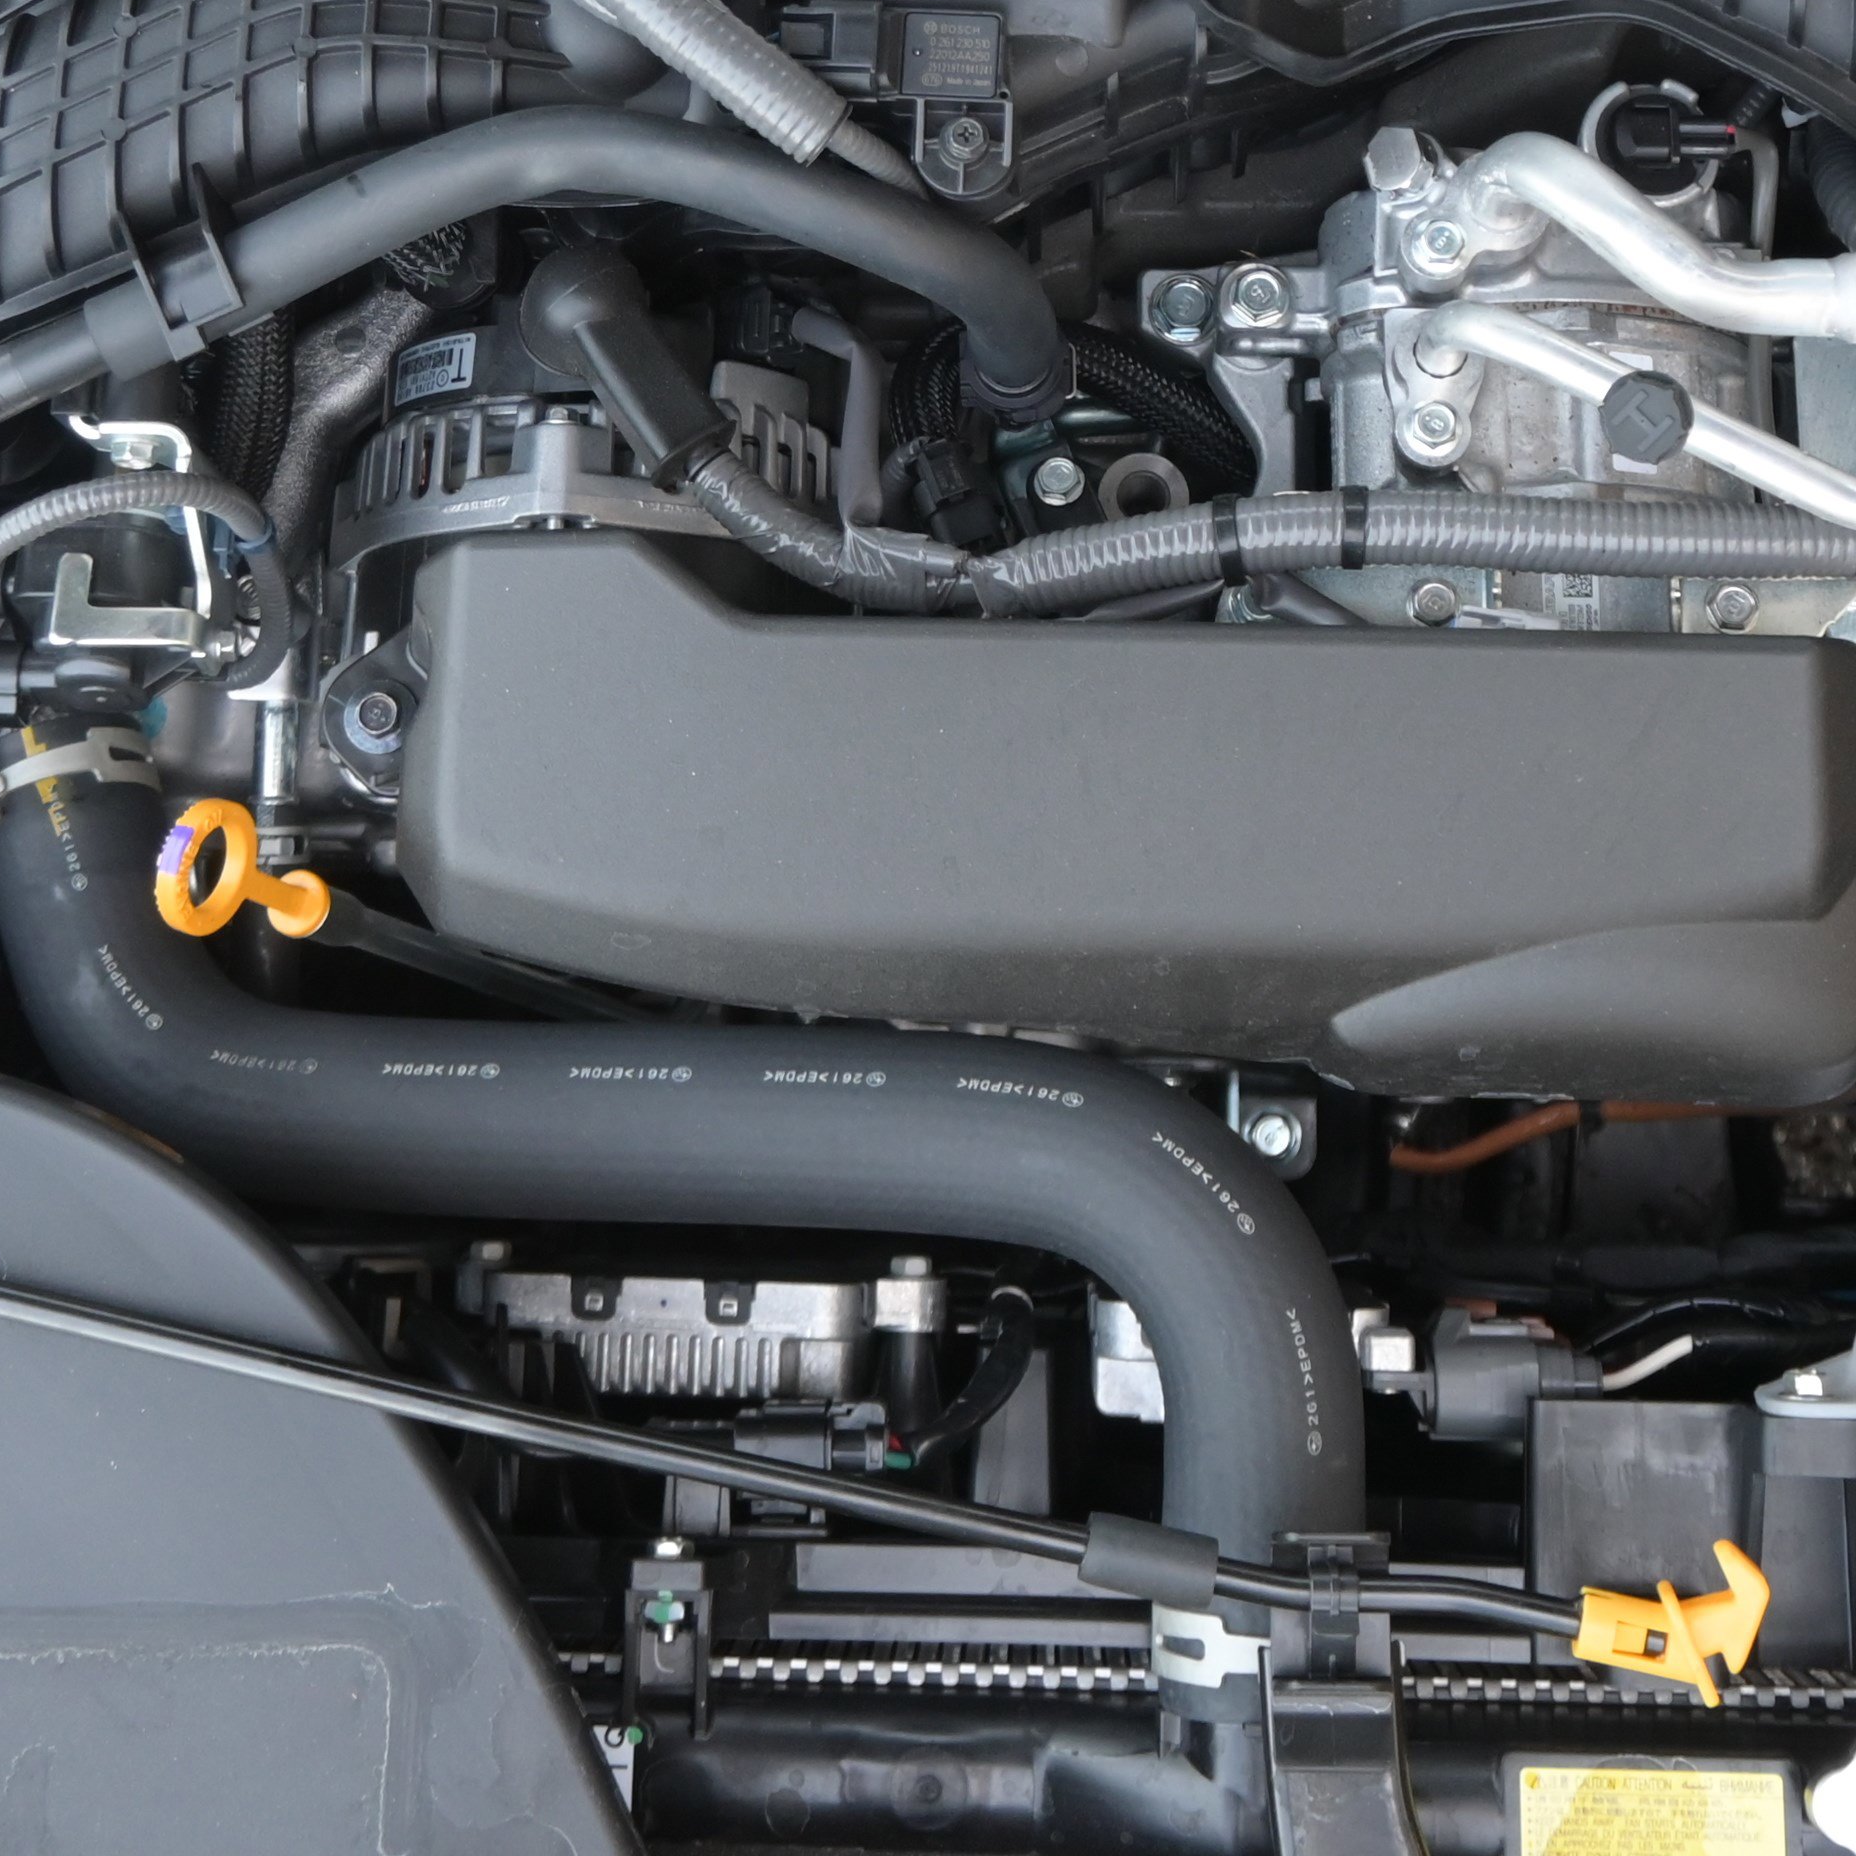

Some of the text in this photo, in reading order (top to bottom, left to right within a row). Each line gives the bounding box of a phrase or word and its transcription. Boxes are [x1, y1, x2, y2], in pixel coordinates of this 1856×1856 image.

[940, 23, 980, 33] BOSCH
[450, 348, 467, 383] T
[1610, 389, 1674, 453] H
[1577, 1777, 1616, 1790] CAUTION
[1622, 1779, 1672, 1791] ATTENTION
